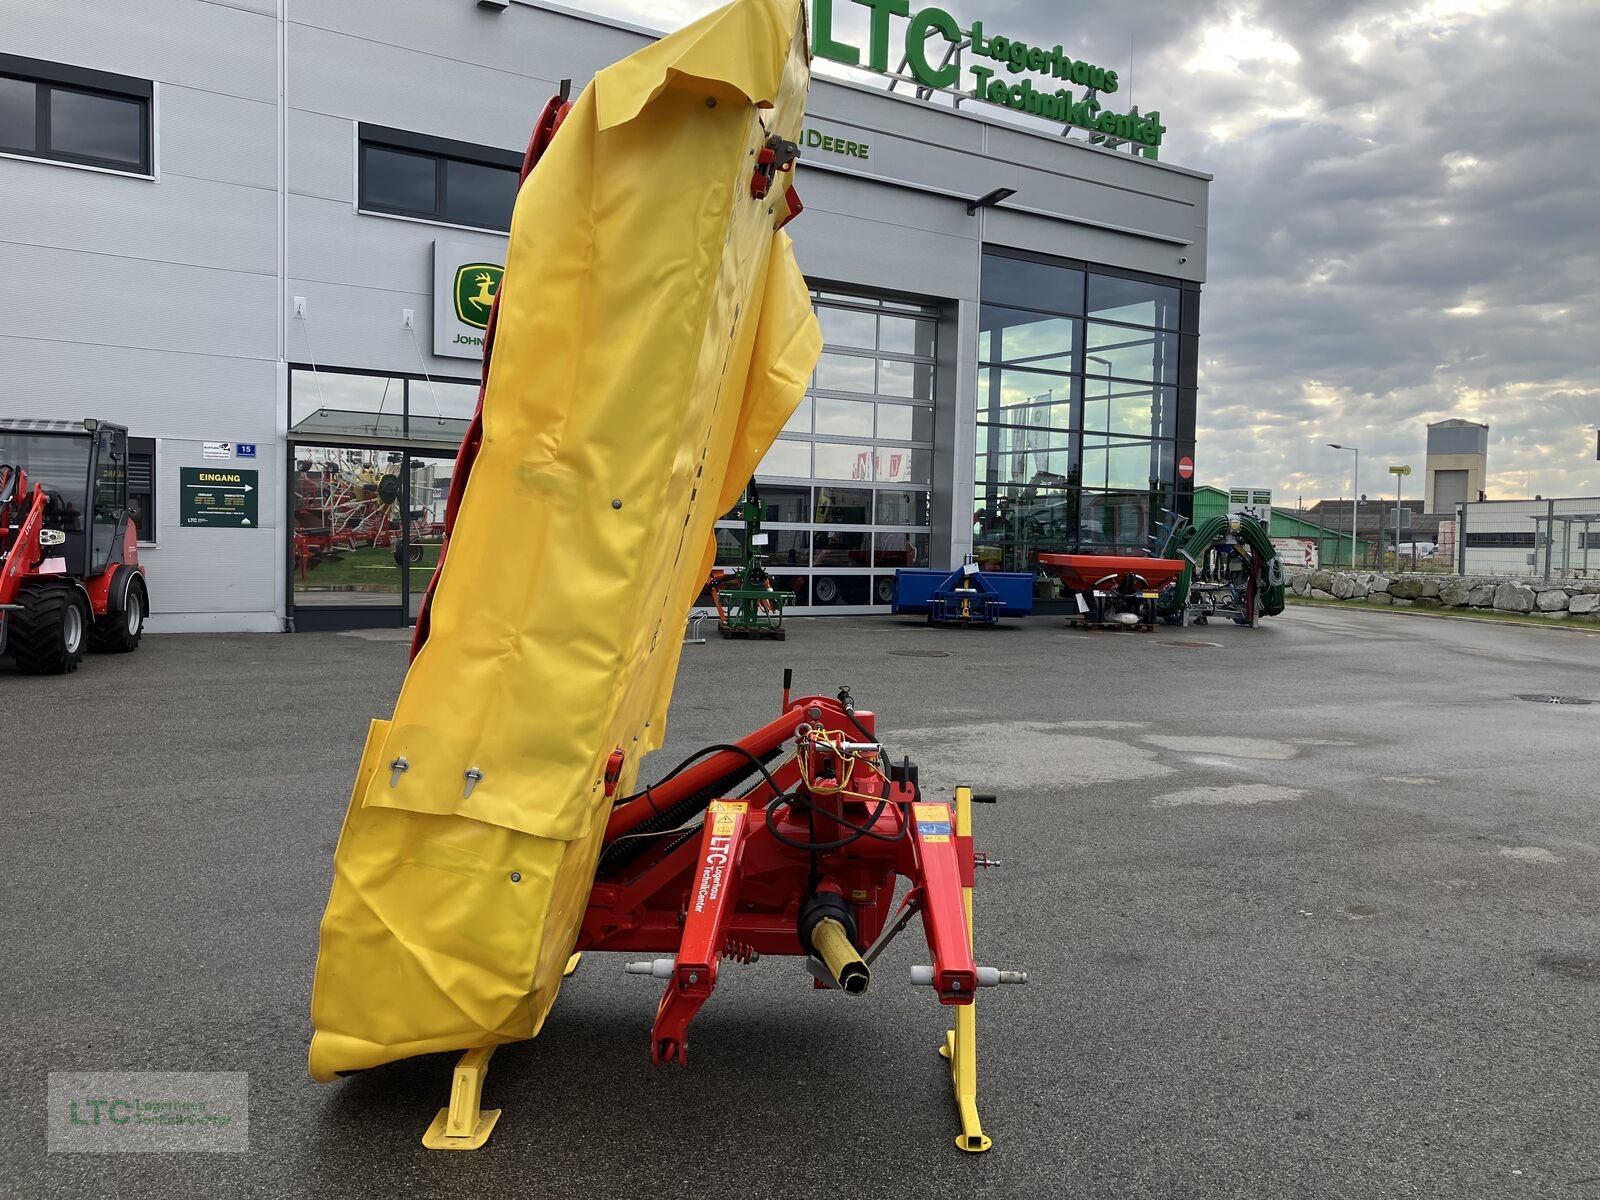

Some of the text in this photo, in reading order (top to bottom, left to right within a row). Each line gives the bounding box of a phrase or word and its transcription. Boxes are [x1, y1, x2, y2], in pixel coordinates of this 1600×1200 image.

[812, 0, 961, 89] LTC
[971, 20, 1119, 94] Lagerhaus
[969, 64, 1167, 147] TechnikCenter
[807, 128, 869, 160] DEERE
[199, 473, 240, 482] EINGANG
[706, 837, 731, 866] LTC
[694, 866, 713, 913] TechnikCenter
[709, 866, 725, 900] Lagerhaus
